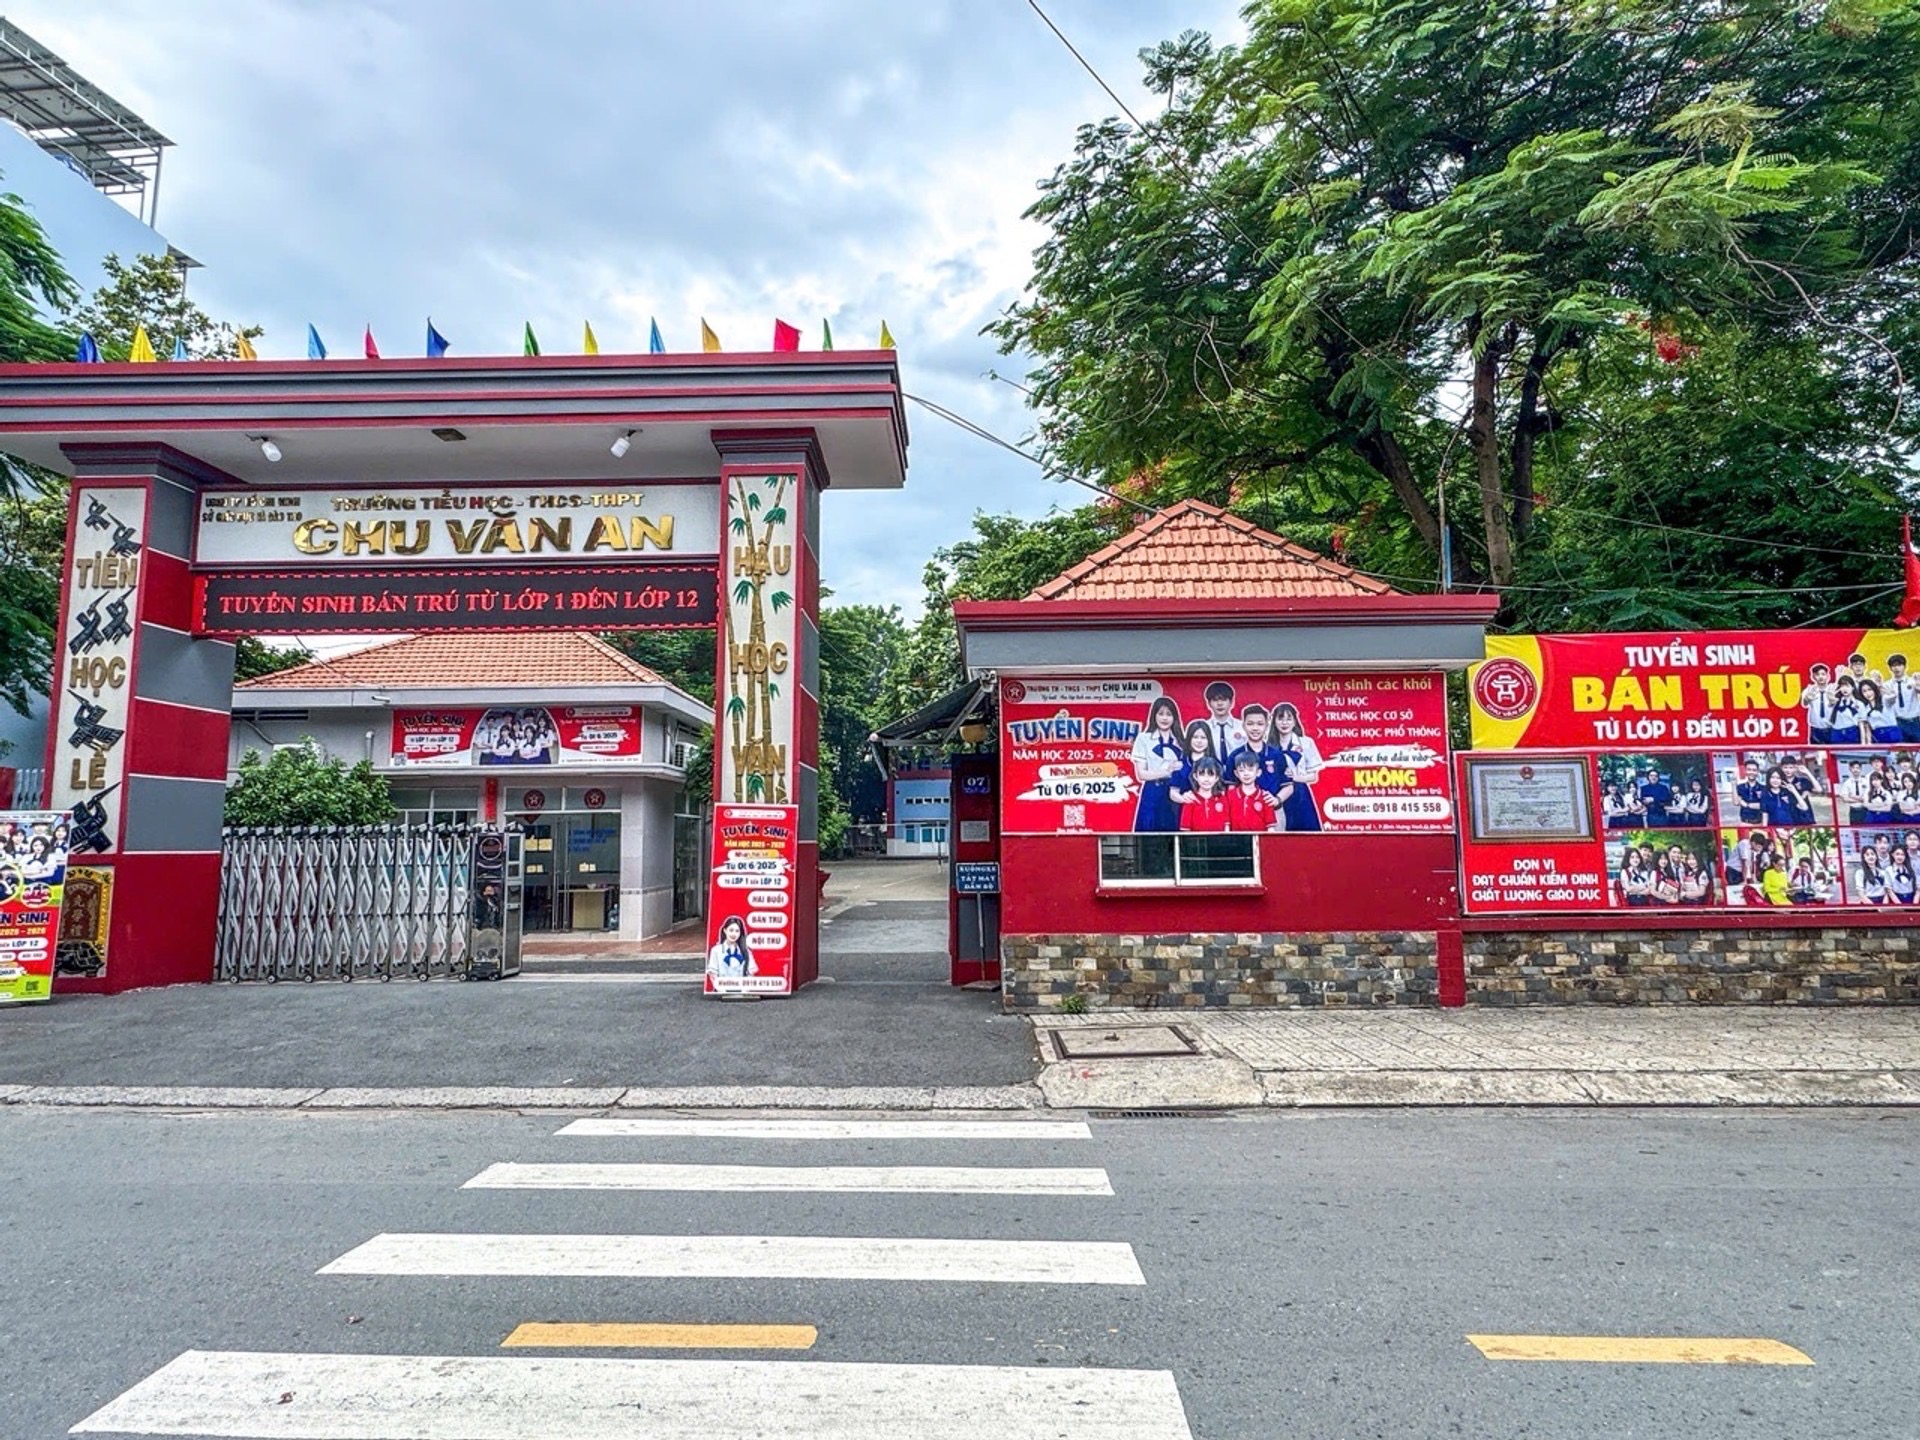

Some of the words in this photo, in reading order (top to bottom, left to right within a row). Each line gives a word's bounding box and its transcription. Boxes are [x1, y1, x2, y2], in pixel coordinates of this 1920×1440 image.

[331, 491, 416, 511] TRƯỜNG
[420, 488, 467, 510] TIỂU
[469, 494, 513, 513] HỌC
[292, 518, 431, 556] CHU
[446, 510, 571, 554] VĂN
[583, 514, 674, 550] AN
[733, 538, 792, 585] HẬU
[76, 551, 138, 589] TIÊN
[301, 595, 356, 614] SINH
[360, 591, 407, 613] BÁN
[413, 590, 460, 613] TRÚ
[466, 588, 499, 611] TỪ
[503, 587, 549, 610] LỚP
[555, 592, 565, 610] 1
[570, 587, 618, 609] ĐẾN
[624, 585, 671, 609] LỚP
[676, 590, 699, 608] 12
[1624, 637, 1699, 668] TUYỂN
[1705, 644, 1756, 666] SINH
[730, 642, 788, 684] HỌC
[69, 656, 126, 698] HỌC
[1303, 677, 1340, 694] Tuyển
[1344, 678, 1372, 691] sinh
[1376, 679, 1399, 690] các
[1402, 676, 1432, 690] khối
[1102, 683, 1120, 692] CHU
[1122, 681, 1138, 691] VĂN
[1140, 682, 1152, 690] AN
[1571, 668, 1684, 713] BÁN
[1699, 665, 1801, 711] TRÚ
[1324, 693, 1345, 706] TIỂU
[1347, 697, 1369, 708] HỌC
[441, 714, 465, 728] SINH
[1324, 711, 1358, 721] TRUNG
[1360, 711, 1381, 722] HỌC
[1400, 708, 1414, 720] SỞ
[1008, 710, 1083, 743] TUYỂN
[1089, 718, 1140, 742] SINH
[1326, 728, 1358, 738] TRUNG
[1361, 728, 1382, 739] HỌC
[1407, 725, 1440, 737] THÔNG
[1593, 717, 1620, 740] TỪ
[1625, 715, 1666, 739] LỚP
[1672, 720, 1680, 738] 1
[1685, 713, 1727, 738] ĐẾN
[1732, 713, 1774, 738] LỚP
[1780, 718, 1799, 737] 12
[731, 736, 786, 776] VĂN
[1012, 748, 1038, 760] NĂM
[1041, 750, 1064, 762] HỌC
[1067, 750, 1094, 760] 2025
[1104, 750, 1132, 760] 2026
[1340, 753, 1354, 762] Xét
[1358, 752, 1373, 764] học
[966, 777, 986, 786] 07
[1354, 766, 1418, 787] KHÔNG
[1037, 783, 1052, 796] Từ
[1055, 781, 1116, 796] 01/6/2025
[1332, 802, 1370, 813] Hotline:
[1373, 802, 1398, 813] 0918
[1401, 802, 1420, 813] 415
[1423, 802, 1442, 812] 558
[722, 822, 760, 837] TUYỂN
[764, 826, 789, 838] SINH
[1542, 859, 1556, 872] VỊ
[760, 876, 772, 885] LỚP
[1472, 874, 1495, 888] ĐẠT
[1498, 870, 1536, 886] CHUẨN
[1540, 870, 1568, 886] KIỂM
[1571, 874, 1599, 887] ĐỊNH
[766, 894, 784, 903] BUỔI
[1472, 886, 1500, 902] CHẤT
[1504, 889, 1542, 903] LƯỢNG
[1546, 888, 1574, 900] GIÁO
[1578, 889, 1602, 902] DỤC
[17, 912, 50, 924] SINH
[752, 936, 764, 945] NỘI
[766, 936, 781, 944] TRÚ
